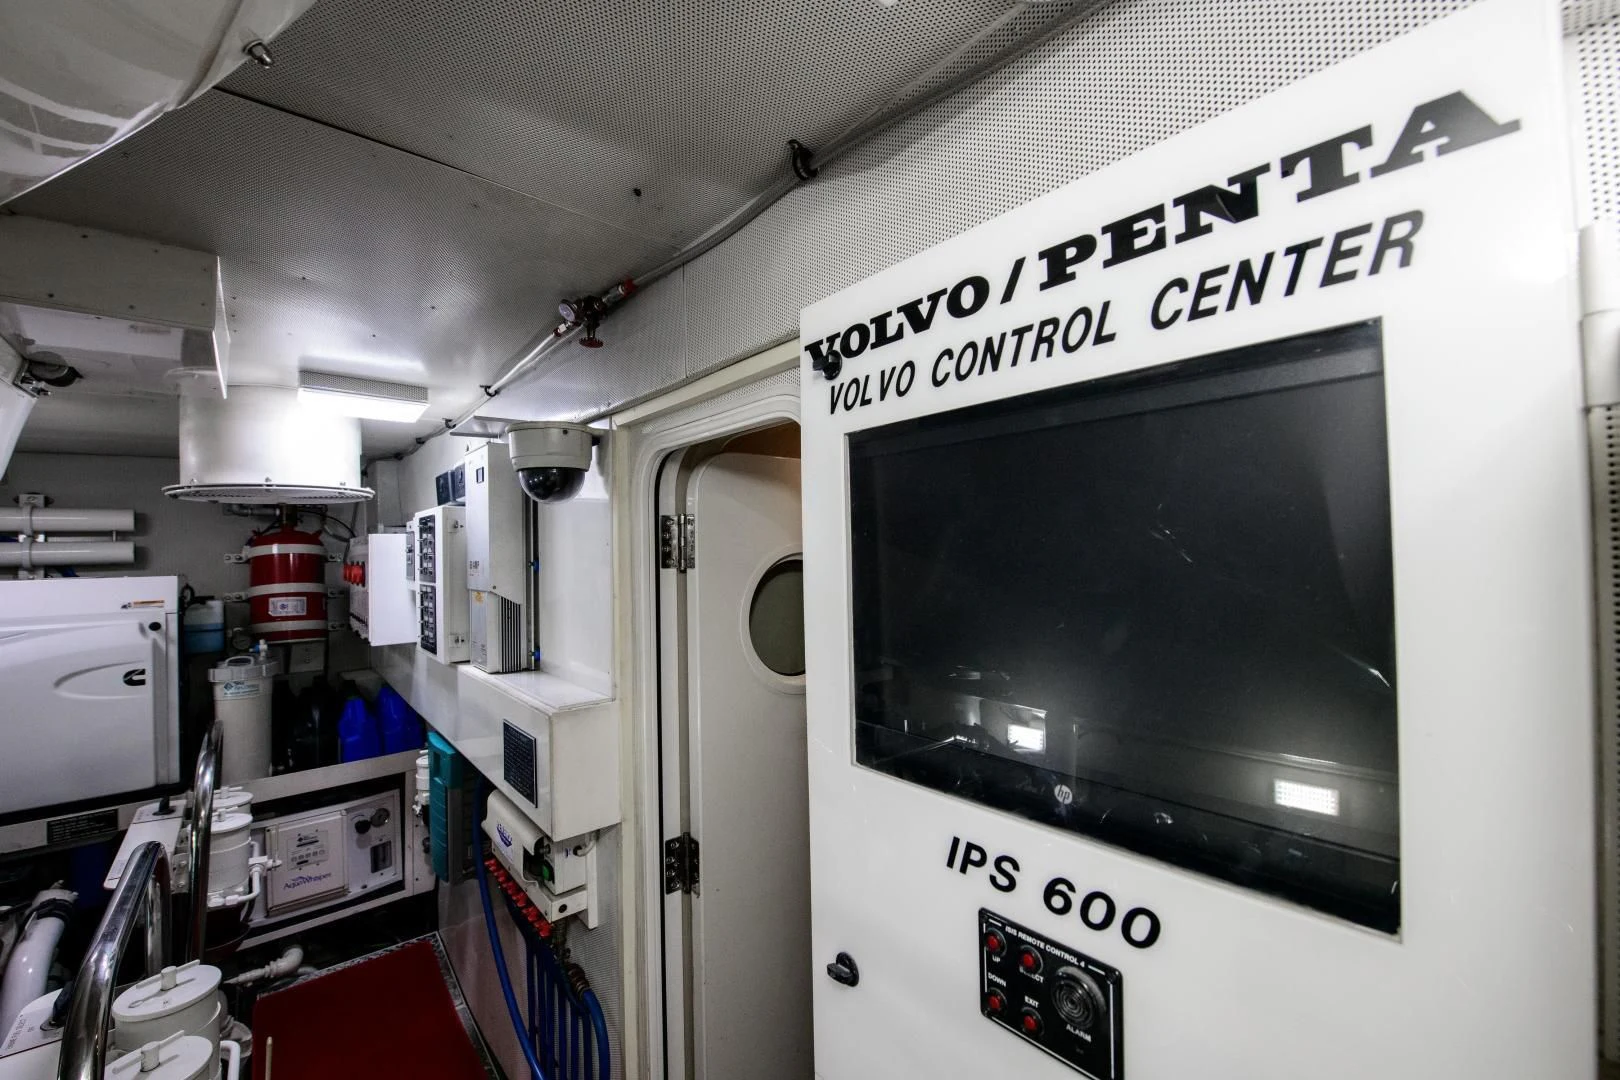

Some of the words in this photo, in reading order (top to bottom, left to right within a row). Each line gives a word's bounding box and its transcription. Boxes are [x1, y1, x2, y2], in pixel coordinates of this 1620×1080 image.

[831, 360, 915, 415] VOLVO
[932, 301, 1116, 388] CONTROL
[1151, 209, 1425, 330] CENTER
[1053, 784, 1070, 804] hp
[947, 836, 1020, 893] IPS
[1043, 877, 1161, 949] 600
[1018, 930, 1045, 949] REMOTE
[1045, 944, 1078, 966] CONTROL
[992, 955, 1001, 963] UP
[988, 972, 1006, 988] DOWN
[1024, 995, 1039, 1008] EXIT
[1066, 1022, 1092, 1043] ALARM
